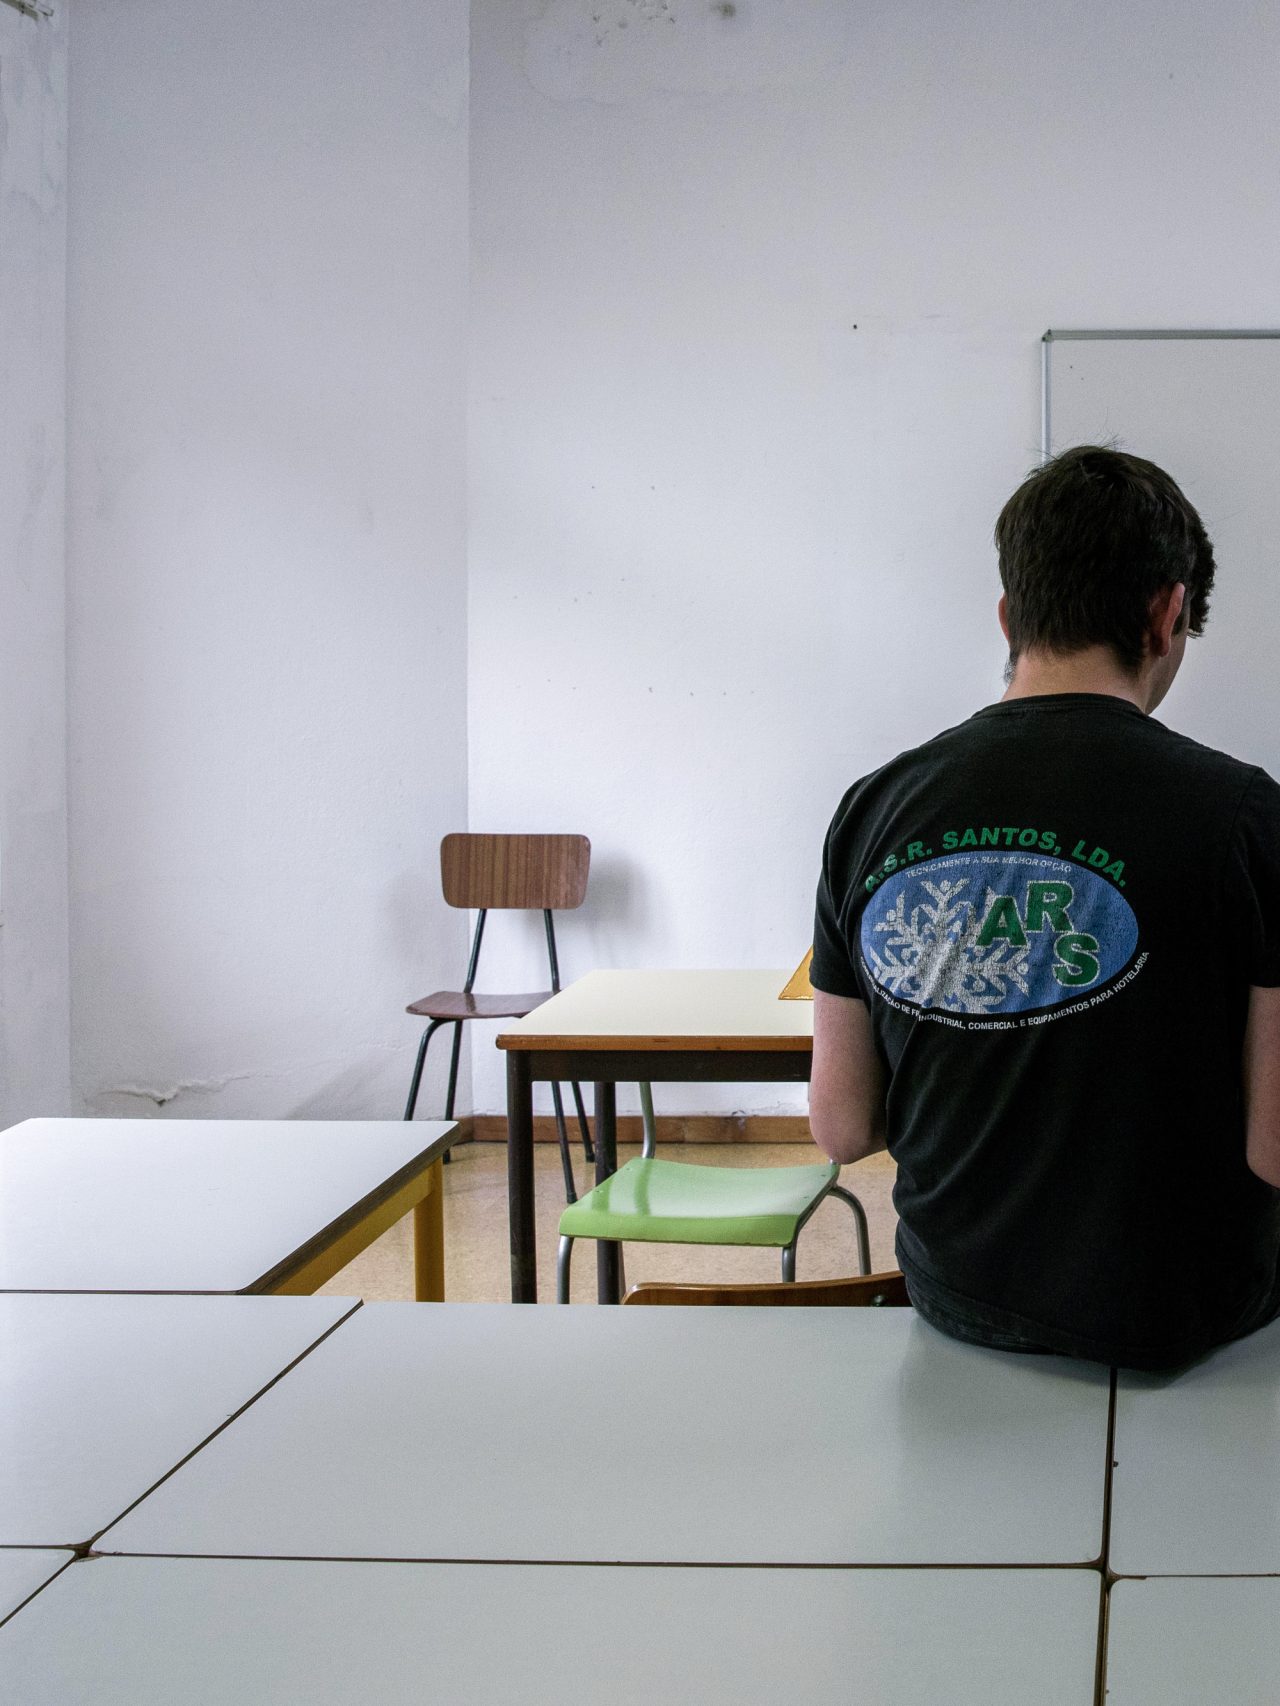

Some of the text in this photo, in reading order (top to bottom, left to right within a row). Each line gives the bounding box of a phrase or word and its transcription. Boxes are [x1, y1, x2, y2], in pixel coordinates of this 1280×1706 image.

[942, 828, 1061, 856] SANTOS,
[1071, 839, 1127, 886] LDA.
[981, 856, 999, 864] SUA
[1002, 856, 1038, 866] MELHOR
[901, 1004, 911, 1014] DE
[968, 1019, 1018, 1030] COMERCIAL
[1020, 1018, 1026, 1027] E
[1028, 1001, 1090, 1026] EQUIPAMENTOS
[1090, 988, 1114, 1006] PARA
[1113, 952, 1150, 993] HOTELARIA
